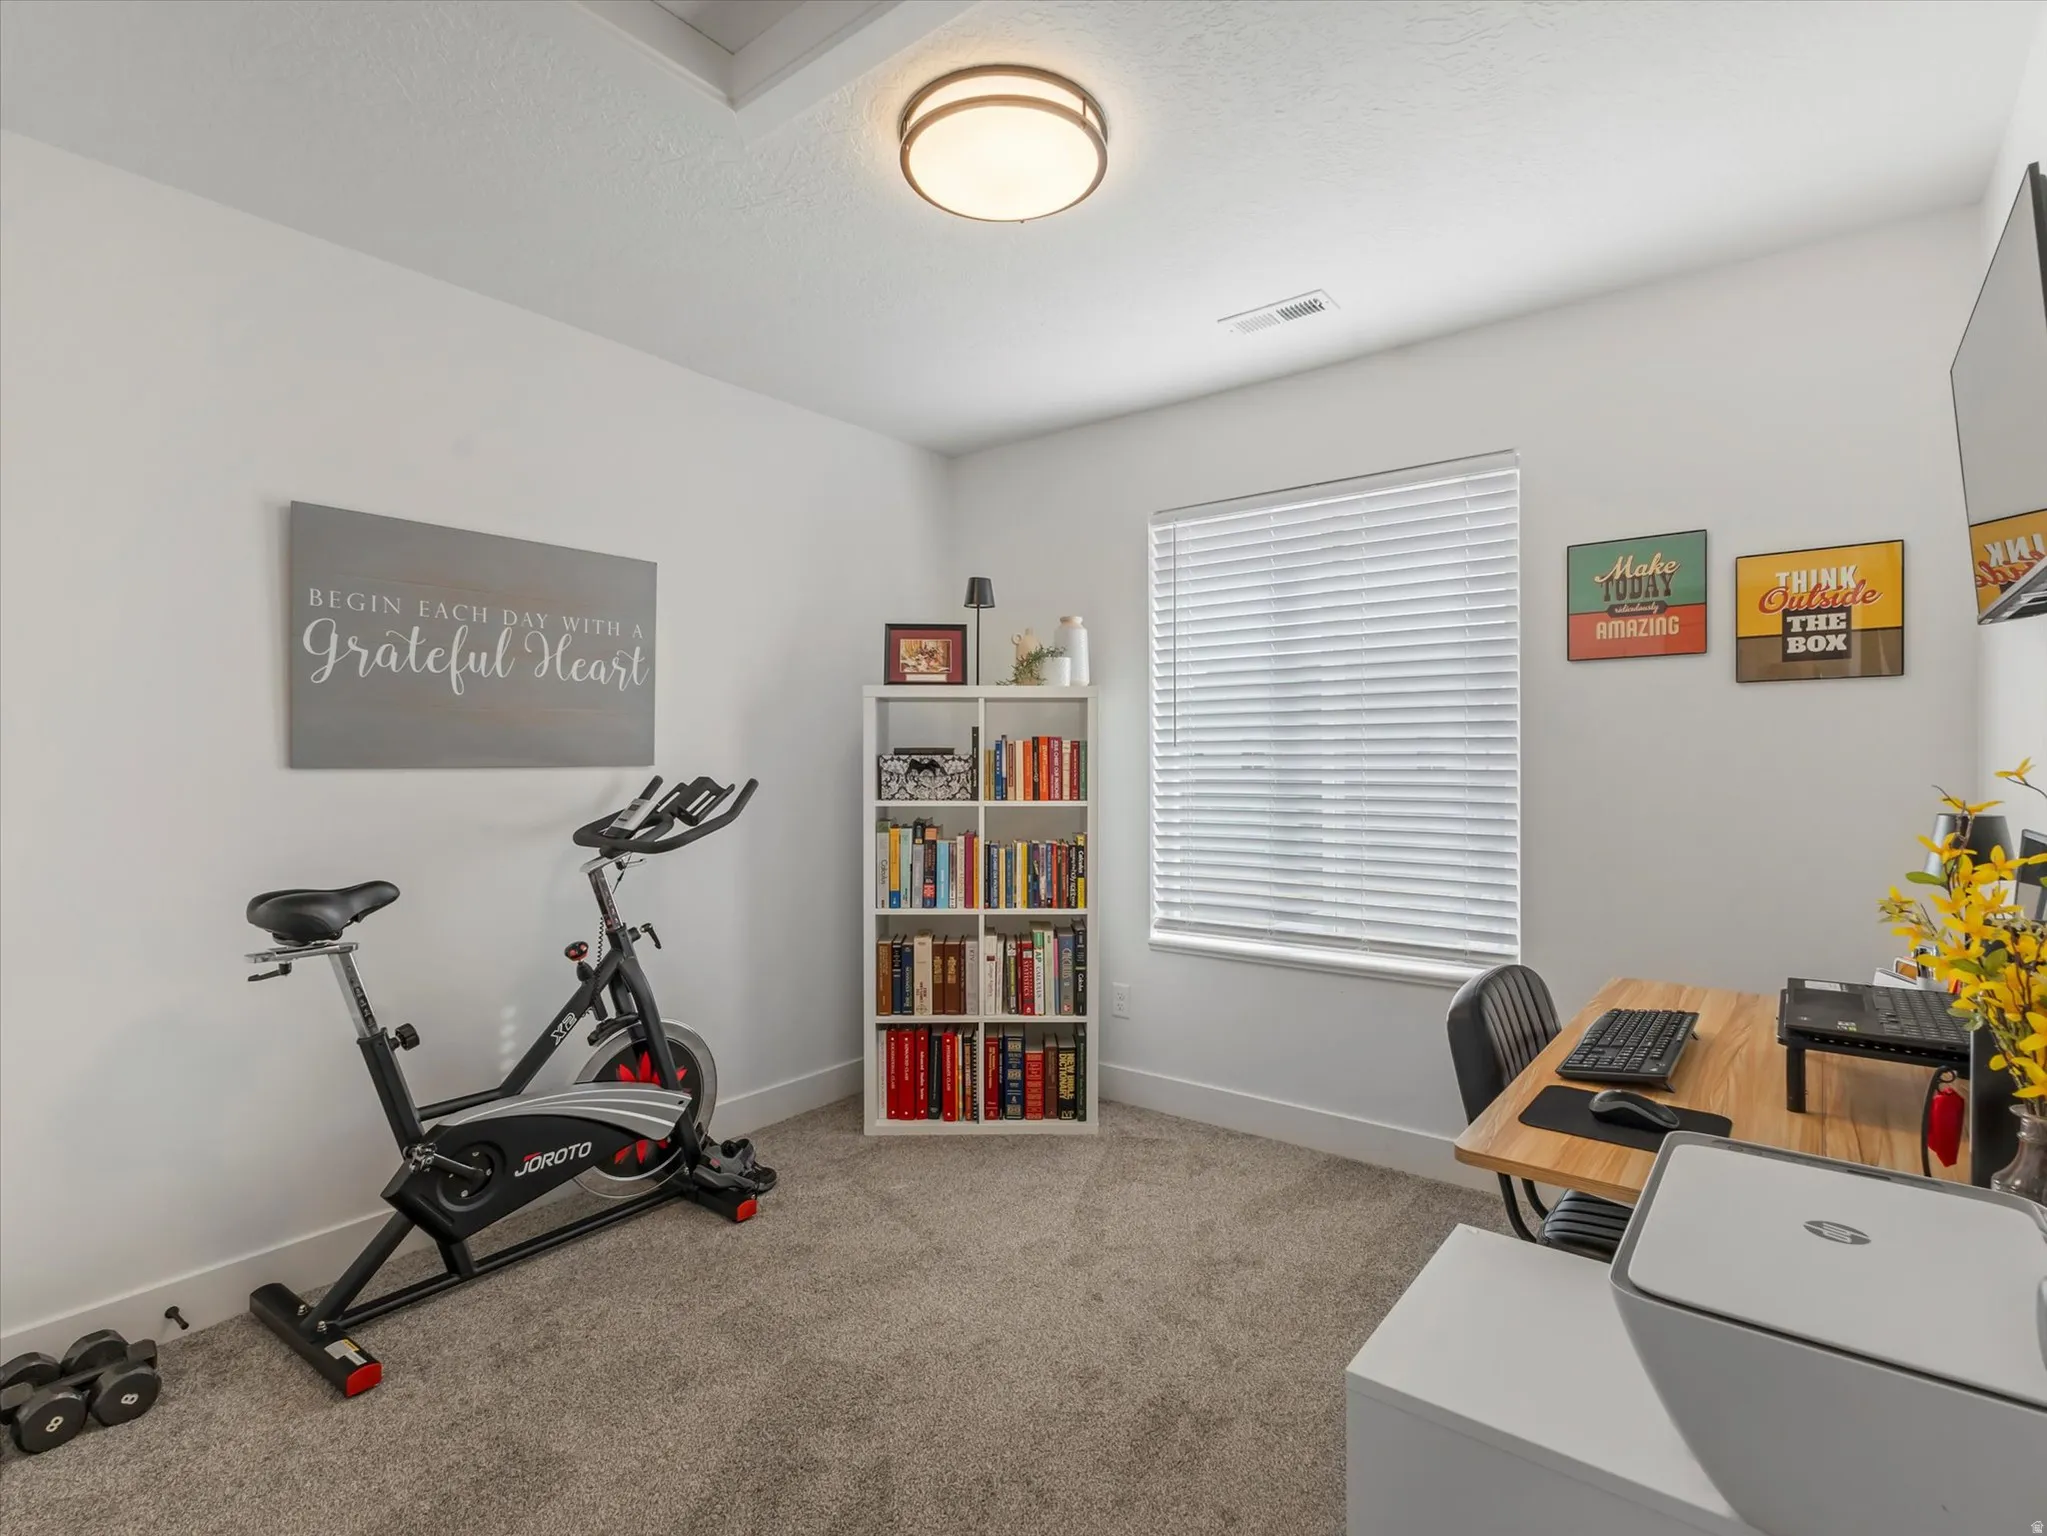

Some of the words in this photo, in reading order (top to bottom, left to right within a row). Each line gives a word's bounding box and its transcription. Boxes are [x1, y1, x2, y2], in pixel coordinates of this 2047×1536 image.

[1594, 552, 1681, 583] Make
[1775, 565, 1858, 593] THINK
[1600, 572, 1675, 602] TODAY
[1758, 579, 1883, 616] Outside
[309, 587, 402, 615] BEGIN
[419, 600, 489, 624] EACH
[503, 609, 550, 630] DAY
[562, 616, 621, 637] WITH
[631, 623, 645, 640] A
[1614, 601, 1660, 614] ridiculously
[1596, 615, 1680, 640] AMAZING
[1786, 612, 1847, 633] THE
[302, 617, 516, 696] Grateful
[524, 630, 651, 692] Heart
[1786, 634, 1848, 654] BOX
[1035, 951, 1042, 963] AP
[1067, 1053, 1075, 1074] NEW
[1059, 1053, 1067, 1100] DICTIONARY
[1067, 1075, 1075, 1100] BIBLE
[514, 1141, 593, 1178] JOROTO
[121, 1393, 139, 1405] 8
[45, 1416, 64, 1433] 8
